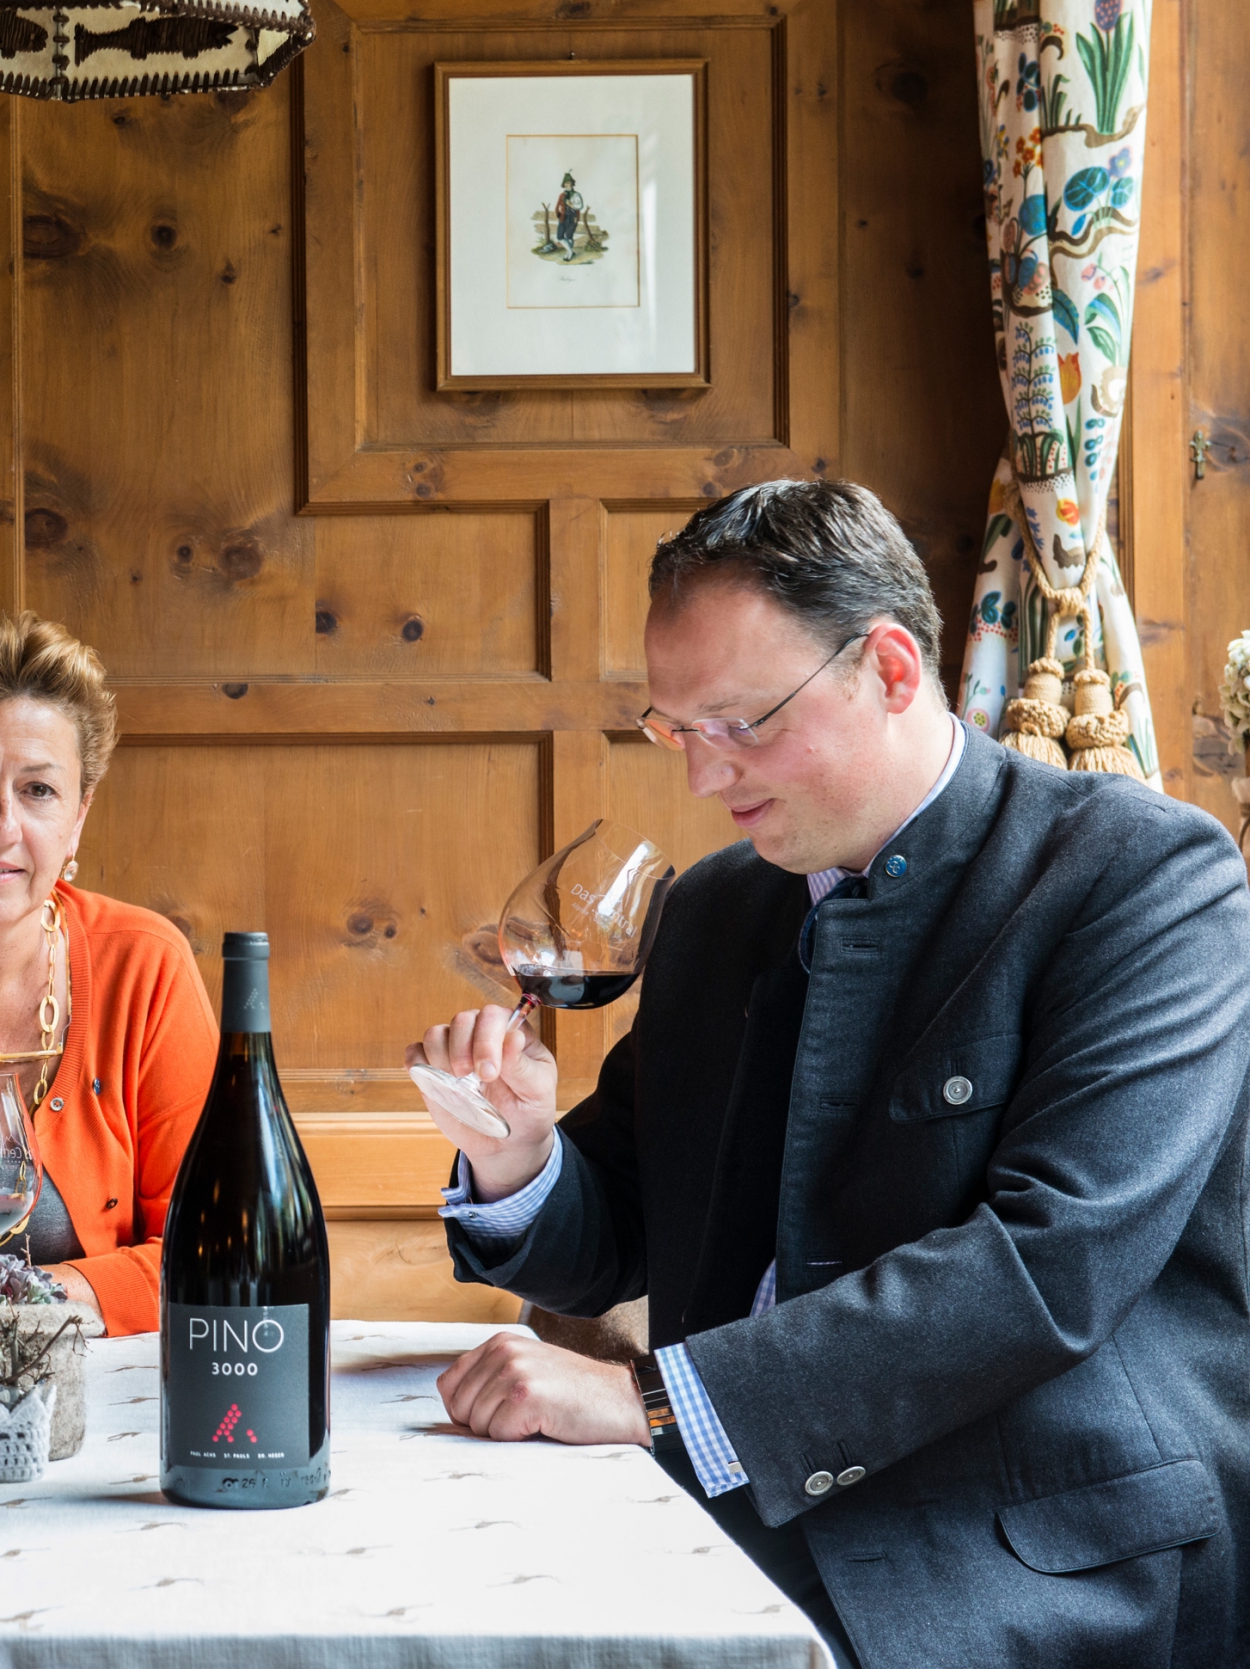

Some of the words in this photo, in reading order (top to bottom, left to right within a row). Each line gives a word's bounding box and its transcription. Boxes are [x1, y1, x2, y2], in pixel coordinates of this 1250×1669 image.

[570, 883, 597, 905] Das
[189, 1318, 285, 1353] PINO
[211, 1362, 259, 1376] 3000
